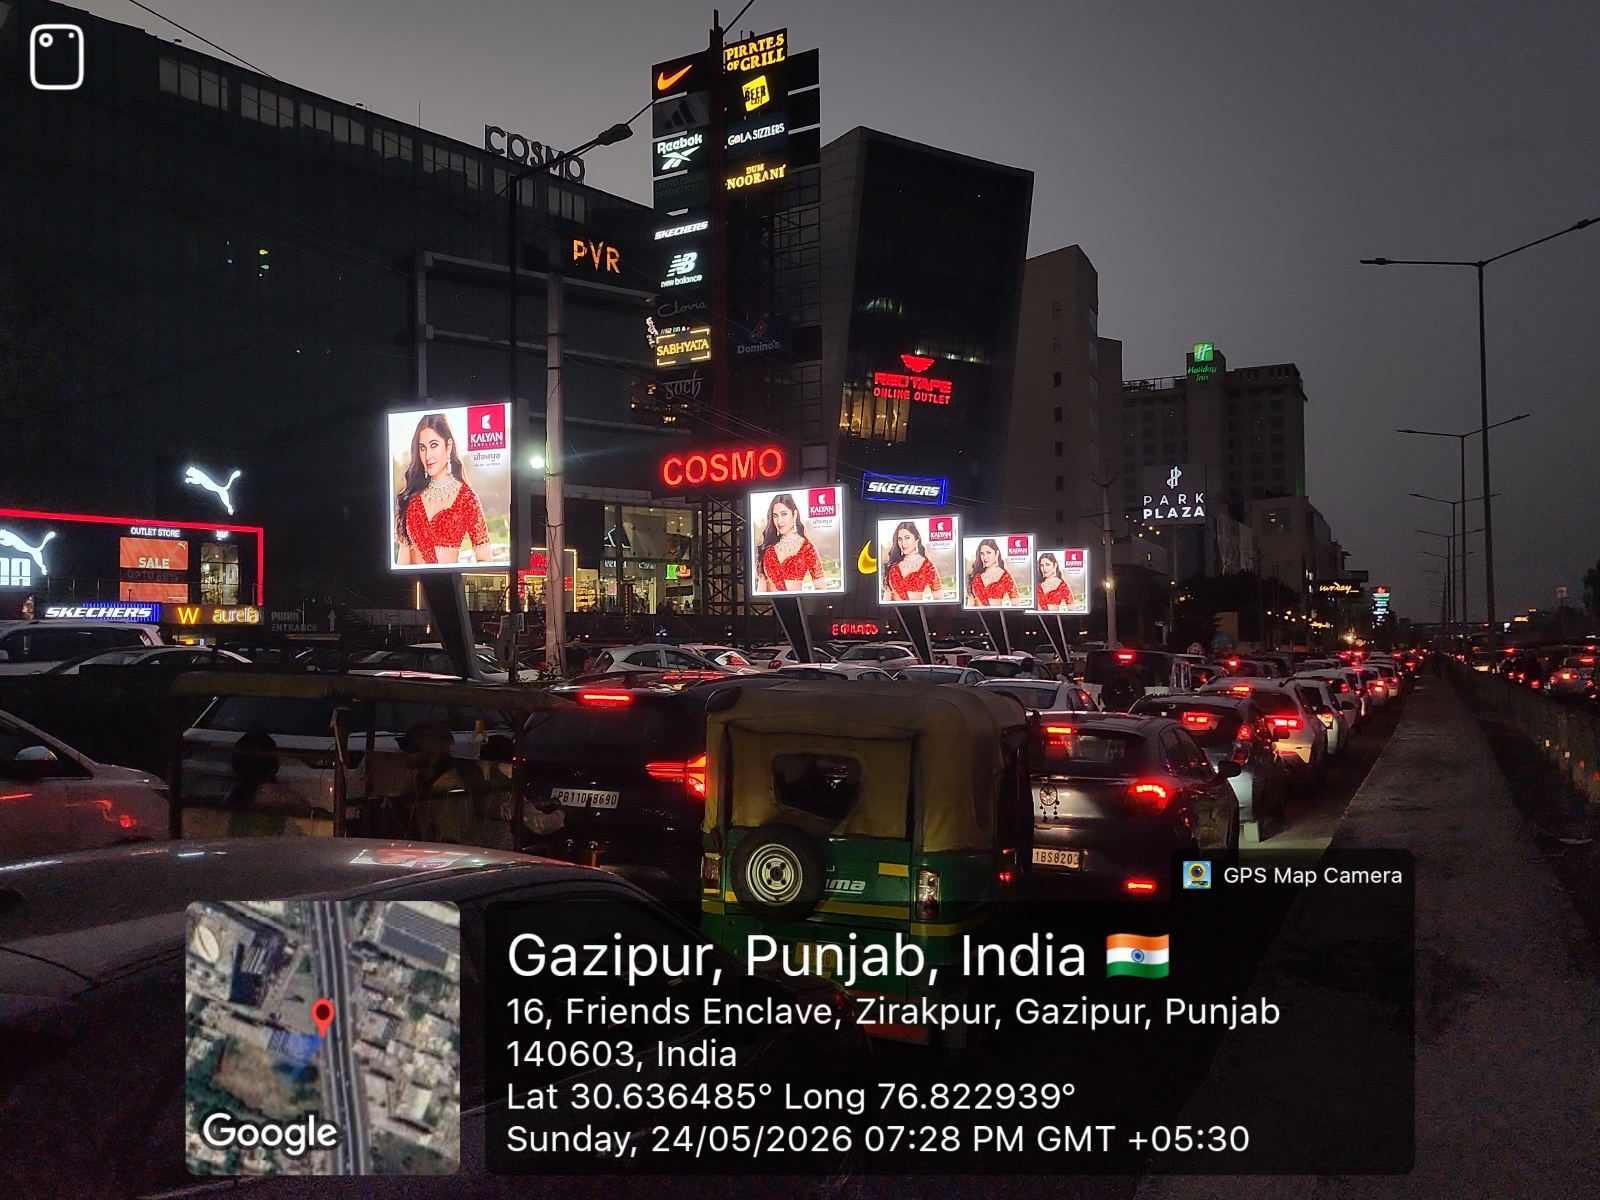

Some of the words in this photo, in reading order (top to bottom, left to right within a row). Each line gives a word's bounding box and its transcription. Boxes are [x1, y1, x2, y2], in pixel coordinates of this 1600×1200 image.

[725, 33, 785, 61] PIRATES
[727, 60, 740, 72] OF
[740, 47, 786, 72] GRILL
[745, 85, 766, 101] BEER
[727, 132, 753, 146] GOLA
[753, 122, 785, 140] SIZZLERS
[657, 133, 703, 155] Reebok
[485, 124, 586, 184] COSMO
[746, 163, 765, 175] DUM
[726, 165, 786, 190] NOORANI
[654, 220, 709, 240] SKECHERS
[573, 239, 621, 273] PVR
[660, 279, 674, 288] new
[674, 274, 703, 286] balance
[656, 338, 710, 357] SABHYATA
[737, 339, 781, 354] Domino's
[1187, 365, 1217, 374] Holiday
[1196, 374, 1209, 382] Inn
[873, 387, 911, 400] ONLINE
[913, 392, 951, 405] OUTLET
[470, 432, 503, 444] KALYAN
[662, 447, 784, 487] COSMO
[868, 481, 940, 498] SKECHERS
[1143, 493, 1205, 506] PARK
[810, 505, 834, 514] KALYAN
[1143, 507, 1206, 520] PLAZA
[130, 527, 157, 537] OUTLET
[158, 528, 180, 538] STORE
[138, 556, 170, 569] SALE
[45, 606, 153, 618] SKECHERS
[178, 606, 201, 624] W
